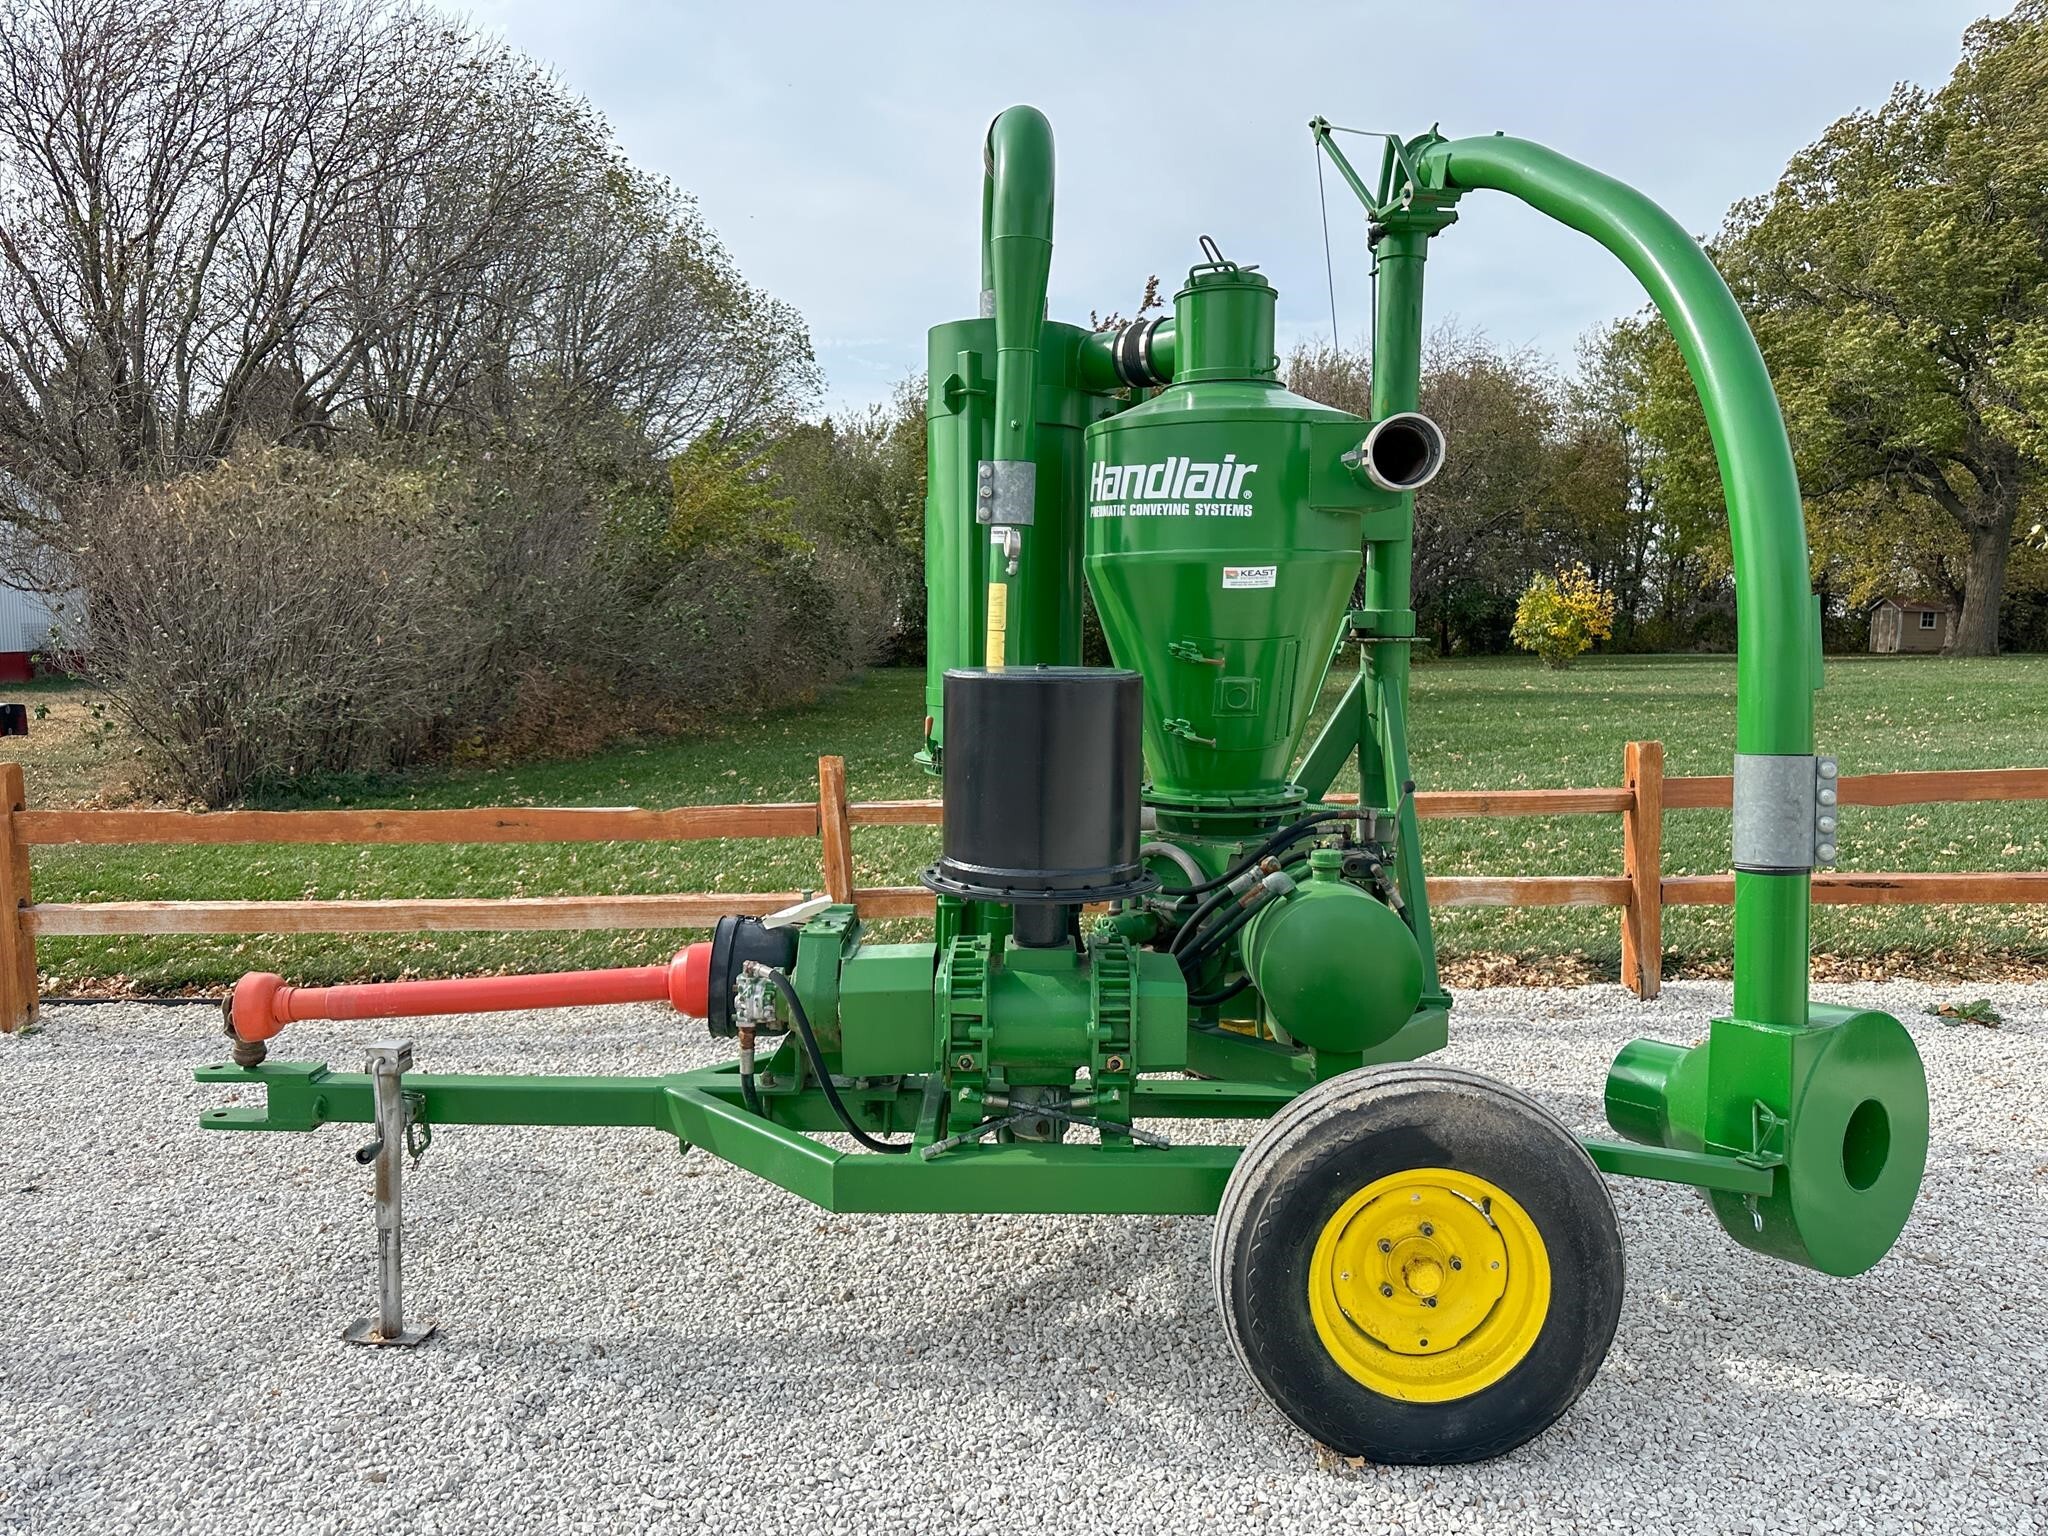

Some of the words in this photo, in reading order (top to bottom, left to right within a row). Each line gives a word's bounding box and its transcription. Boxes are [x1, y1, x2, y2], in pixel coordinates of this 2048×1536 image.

[1090, 504, 1126, 518] PNEUMATIC
[1129, 503, 1190, 516] CONVEYING
[1195, 504, 1253, 517] SYSTEMS
[1240, 569, 1275, 577] KEAST
